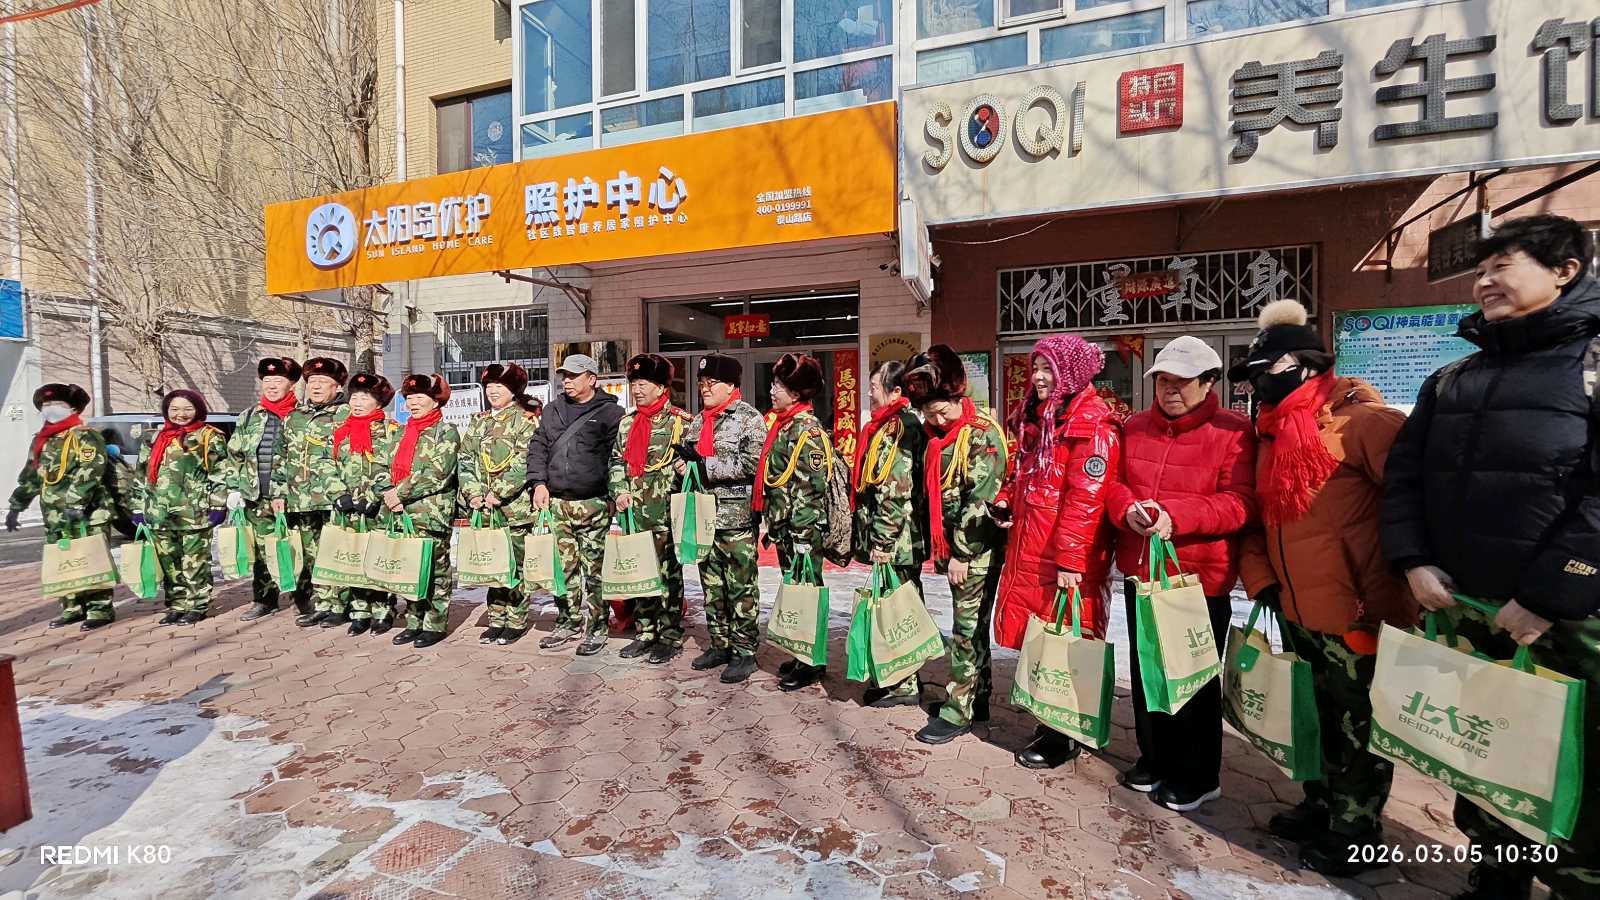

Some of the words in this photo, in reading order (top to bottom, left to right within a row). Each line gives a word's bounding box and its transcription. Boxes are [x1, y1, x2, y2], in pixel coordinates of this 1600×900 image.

[923, 80, 1086, 170] SOQI
[363, 193, 491, 247] 太阳岛优护
[524, 165, 687, 224] 照护中心
[366, 250, 385, 259] SUN
[391, 244, 425, 256] ISLAND
[432, 239, 460, 250] HOME
[468, 235, 493, 246] CARE
[1398, 713, 1489, 760] BEIDAHUANG
